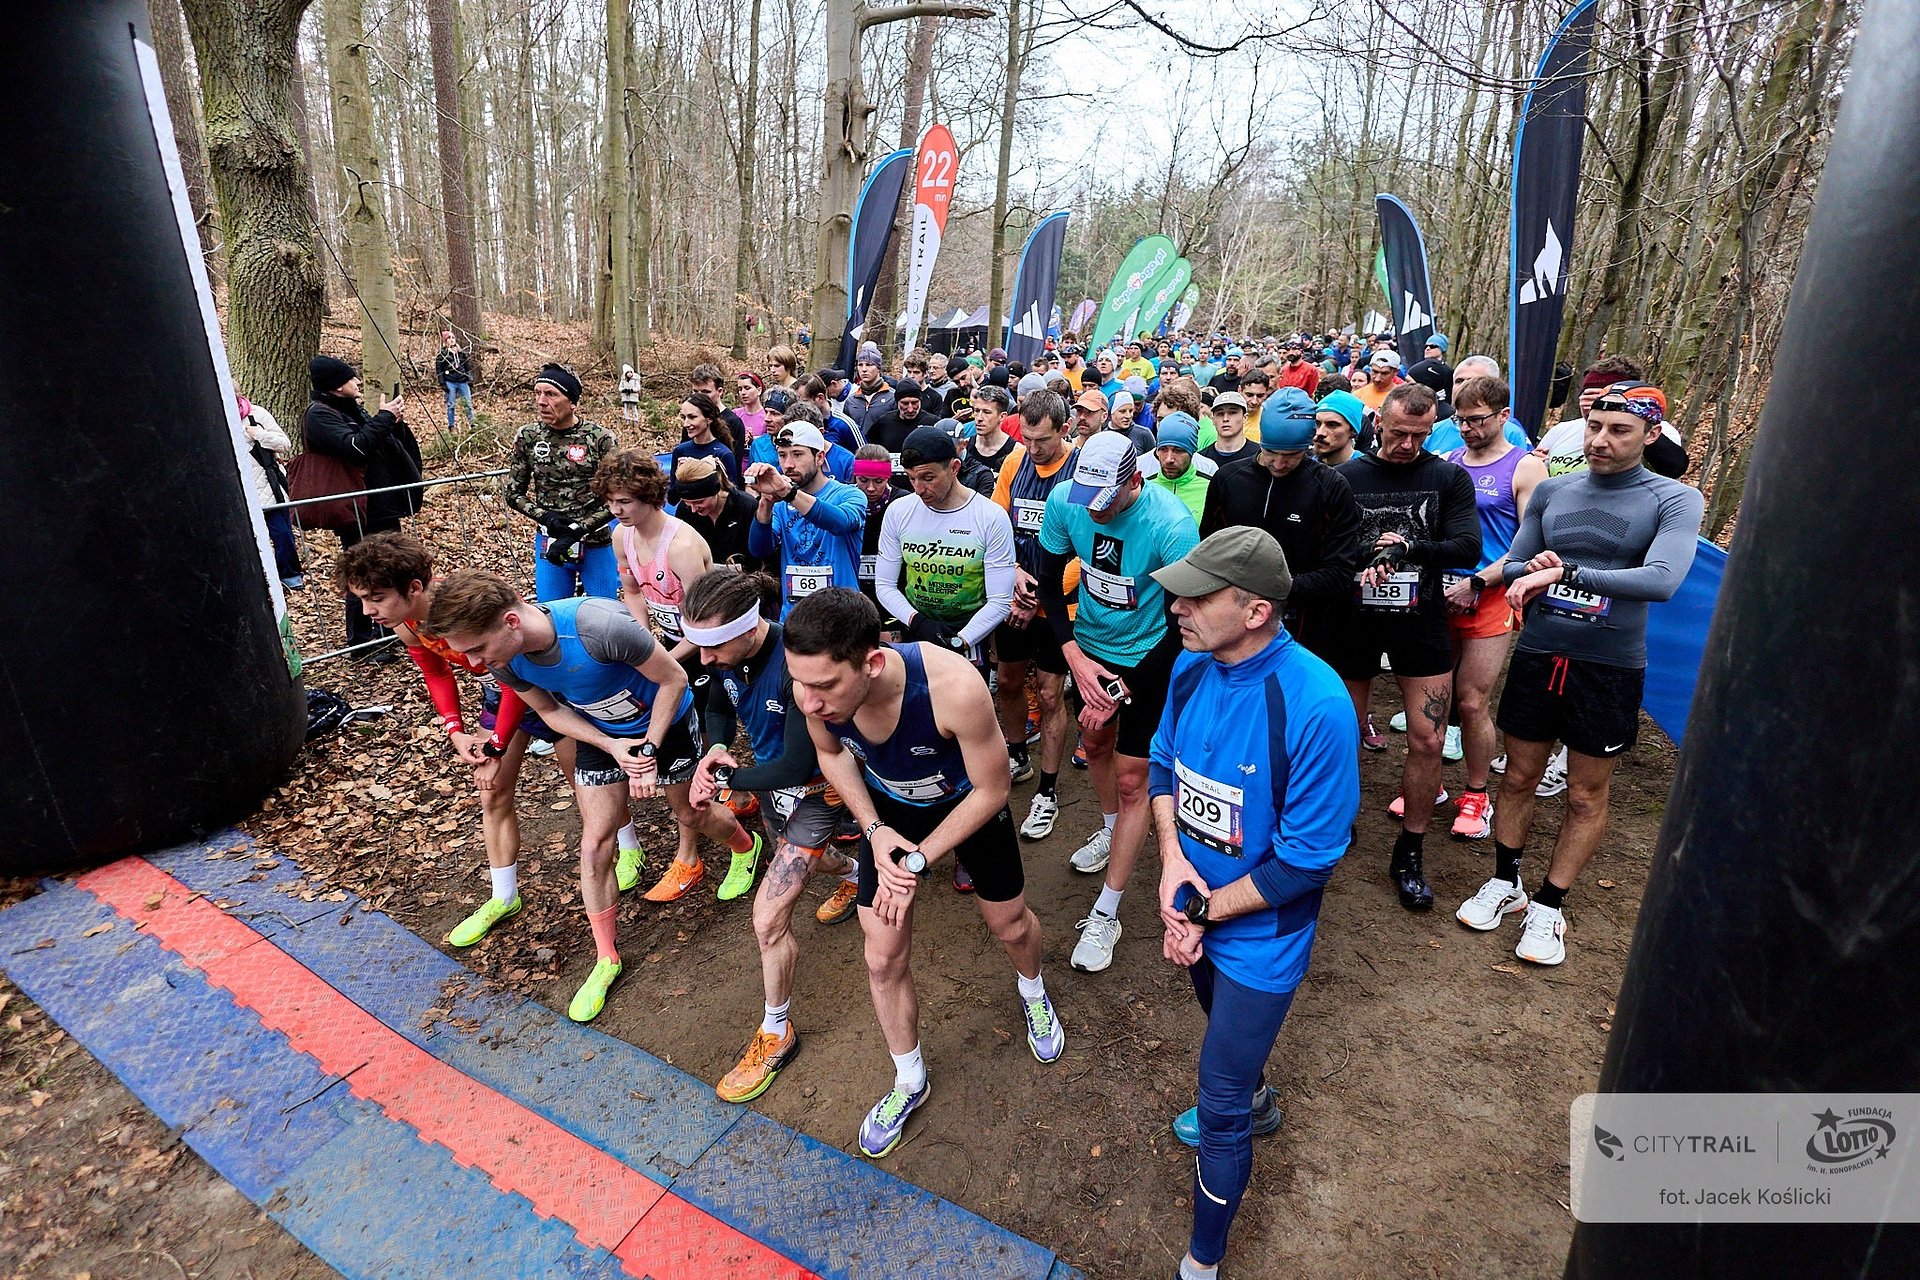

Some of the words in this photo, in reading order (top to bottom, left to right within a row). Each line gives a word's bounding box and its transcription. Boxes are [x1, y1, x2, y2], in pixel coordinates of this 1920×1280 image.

[921, 150, 951, 188] 22
[934, 191, 947, 202] min
[1022, 510, 1044, 524] 376
[799, 578, 818, 590] 68
[1100, 581, 1110, 594] 5
[1369, 585, 1401, 598] 158
[1182, 788, 1221, 823] 209
